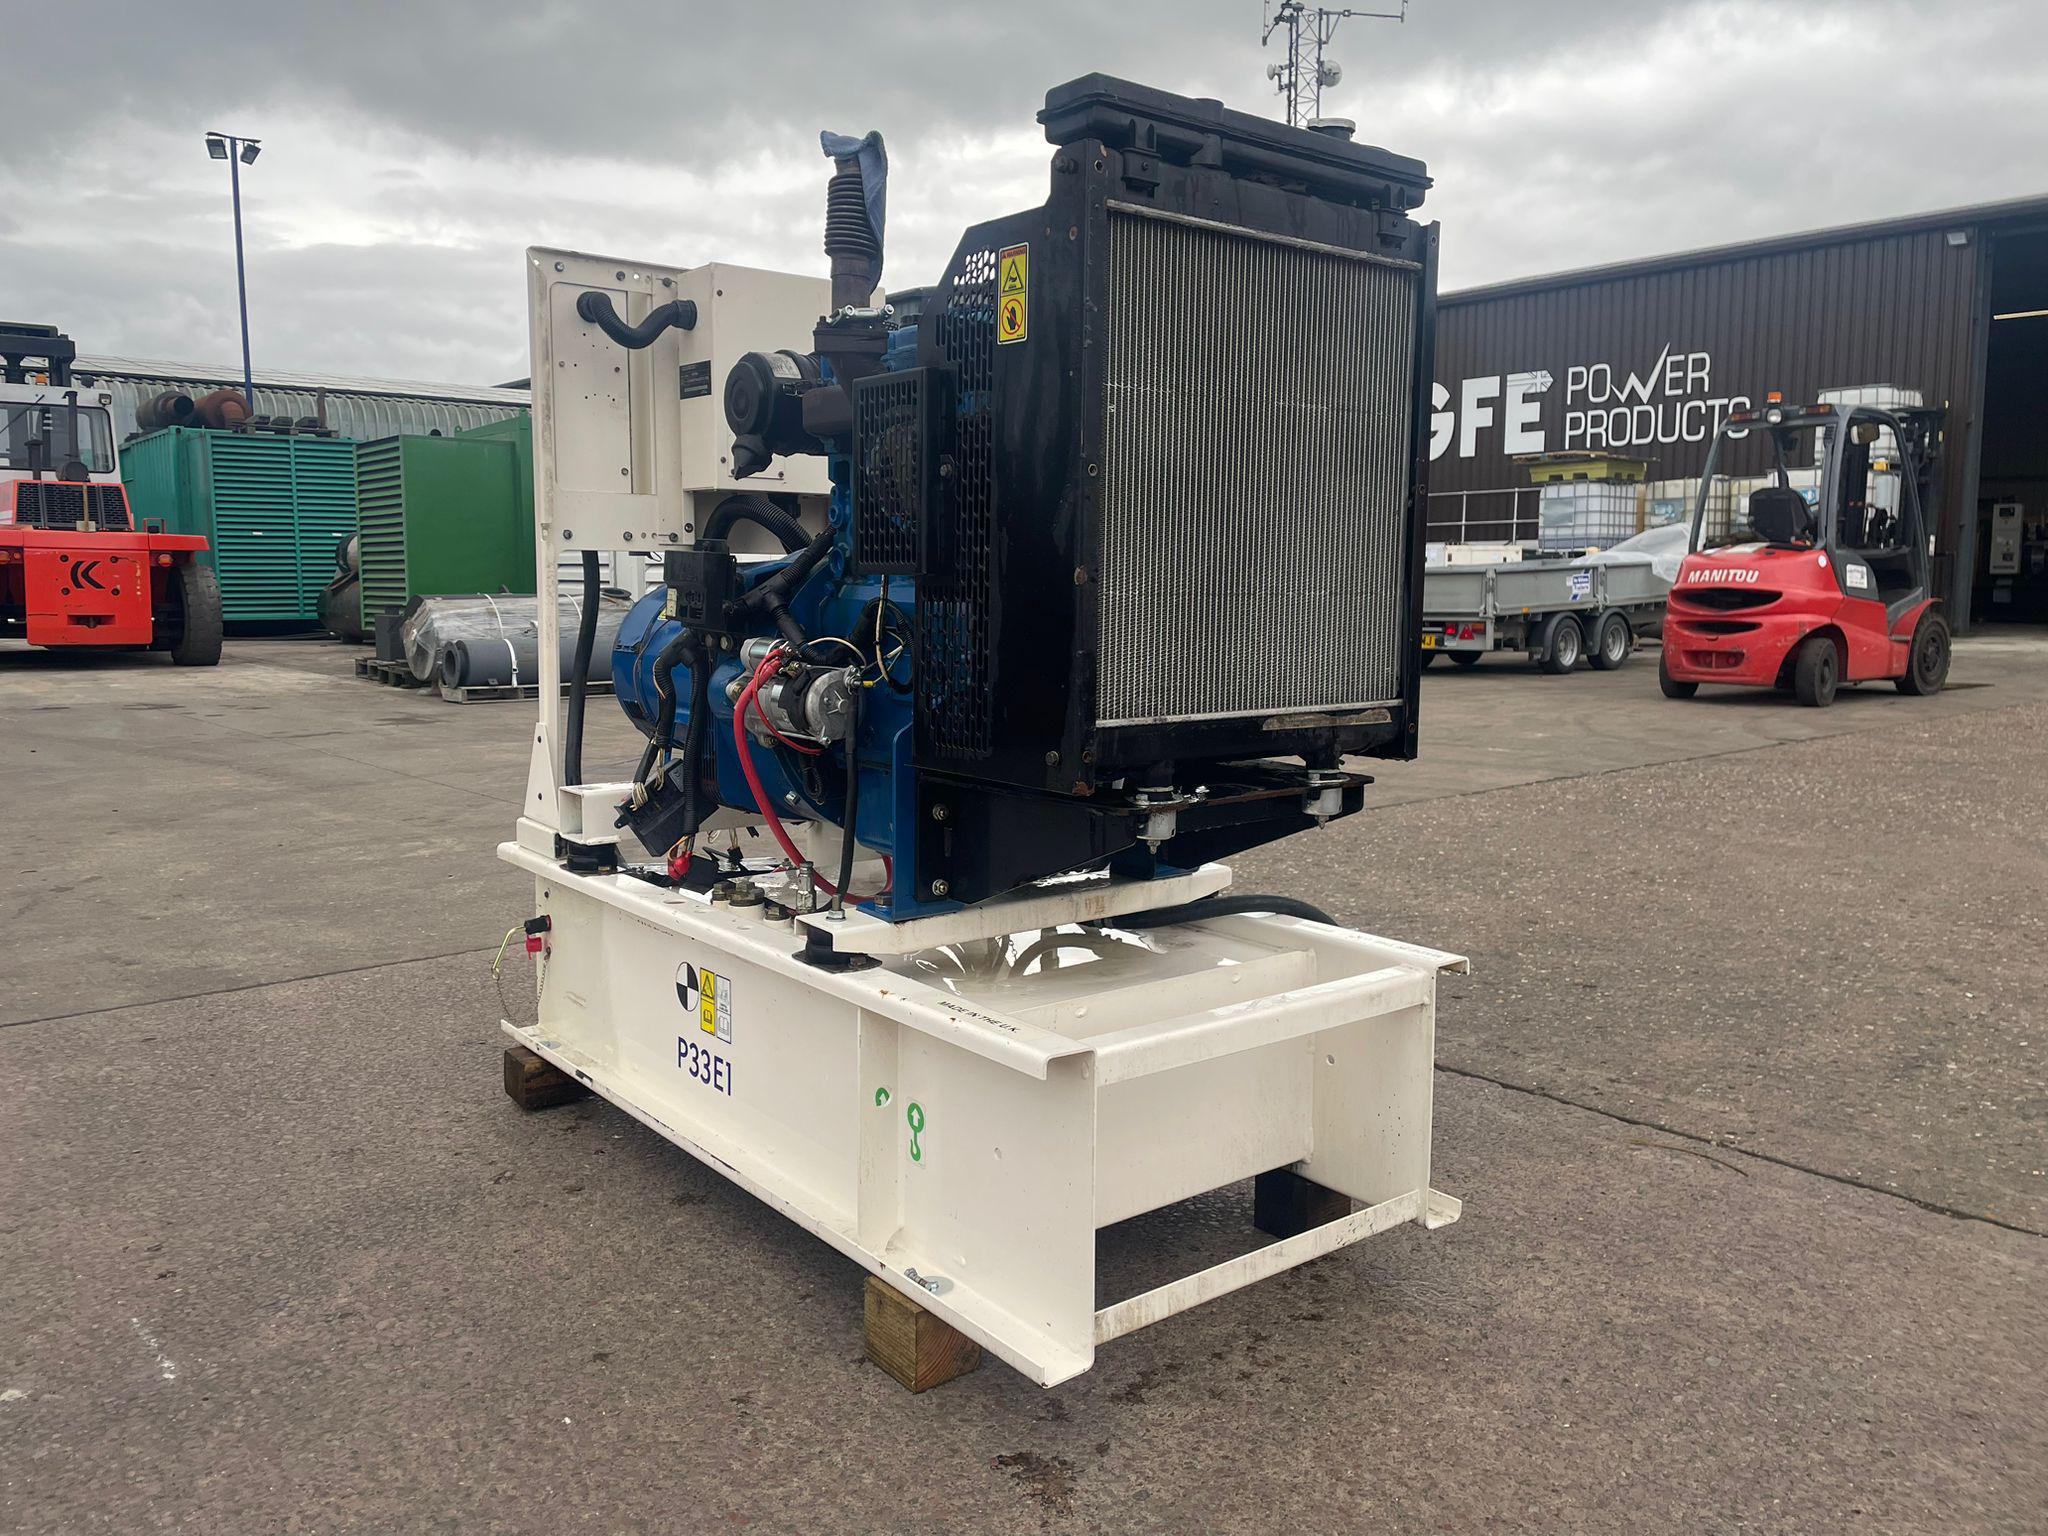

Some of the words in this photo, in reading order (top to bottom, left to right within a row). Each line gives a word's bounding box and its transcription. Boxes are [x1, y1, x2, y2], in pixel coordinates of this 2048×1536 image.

[1566, 342, 1711, 406] POWER
[1565, 396, 1751, 450] PRODUCTS
[1687, 569, 1760, 584] MANITOU
[937, 1001, 970, 1013] MADE
[678, 1036, 732, 1097] P33E1
